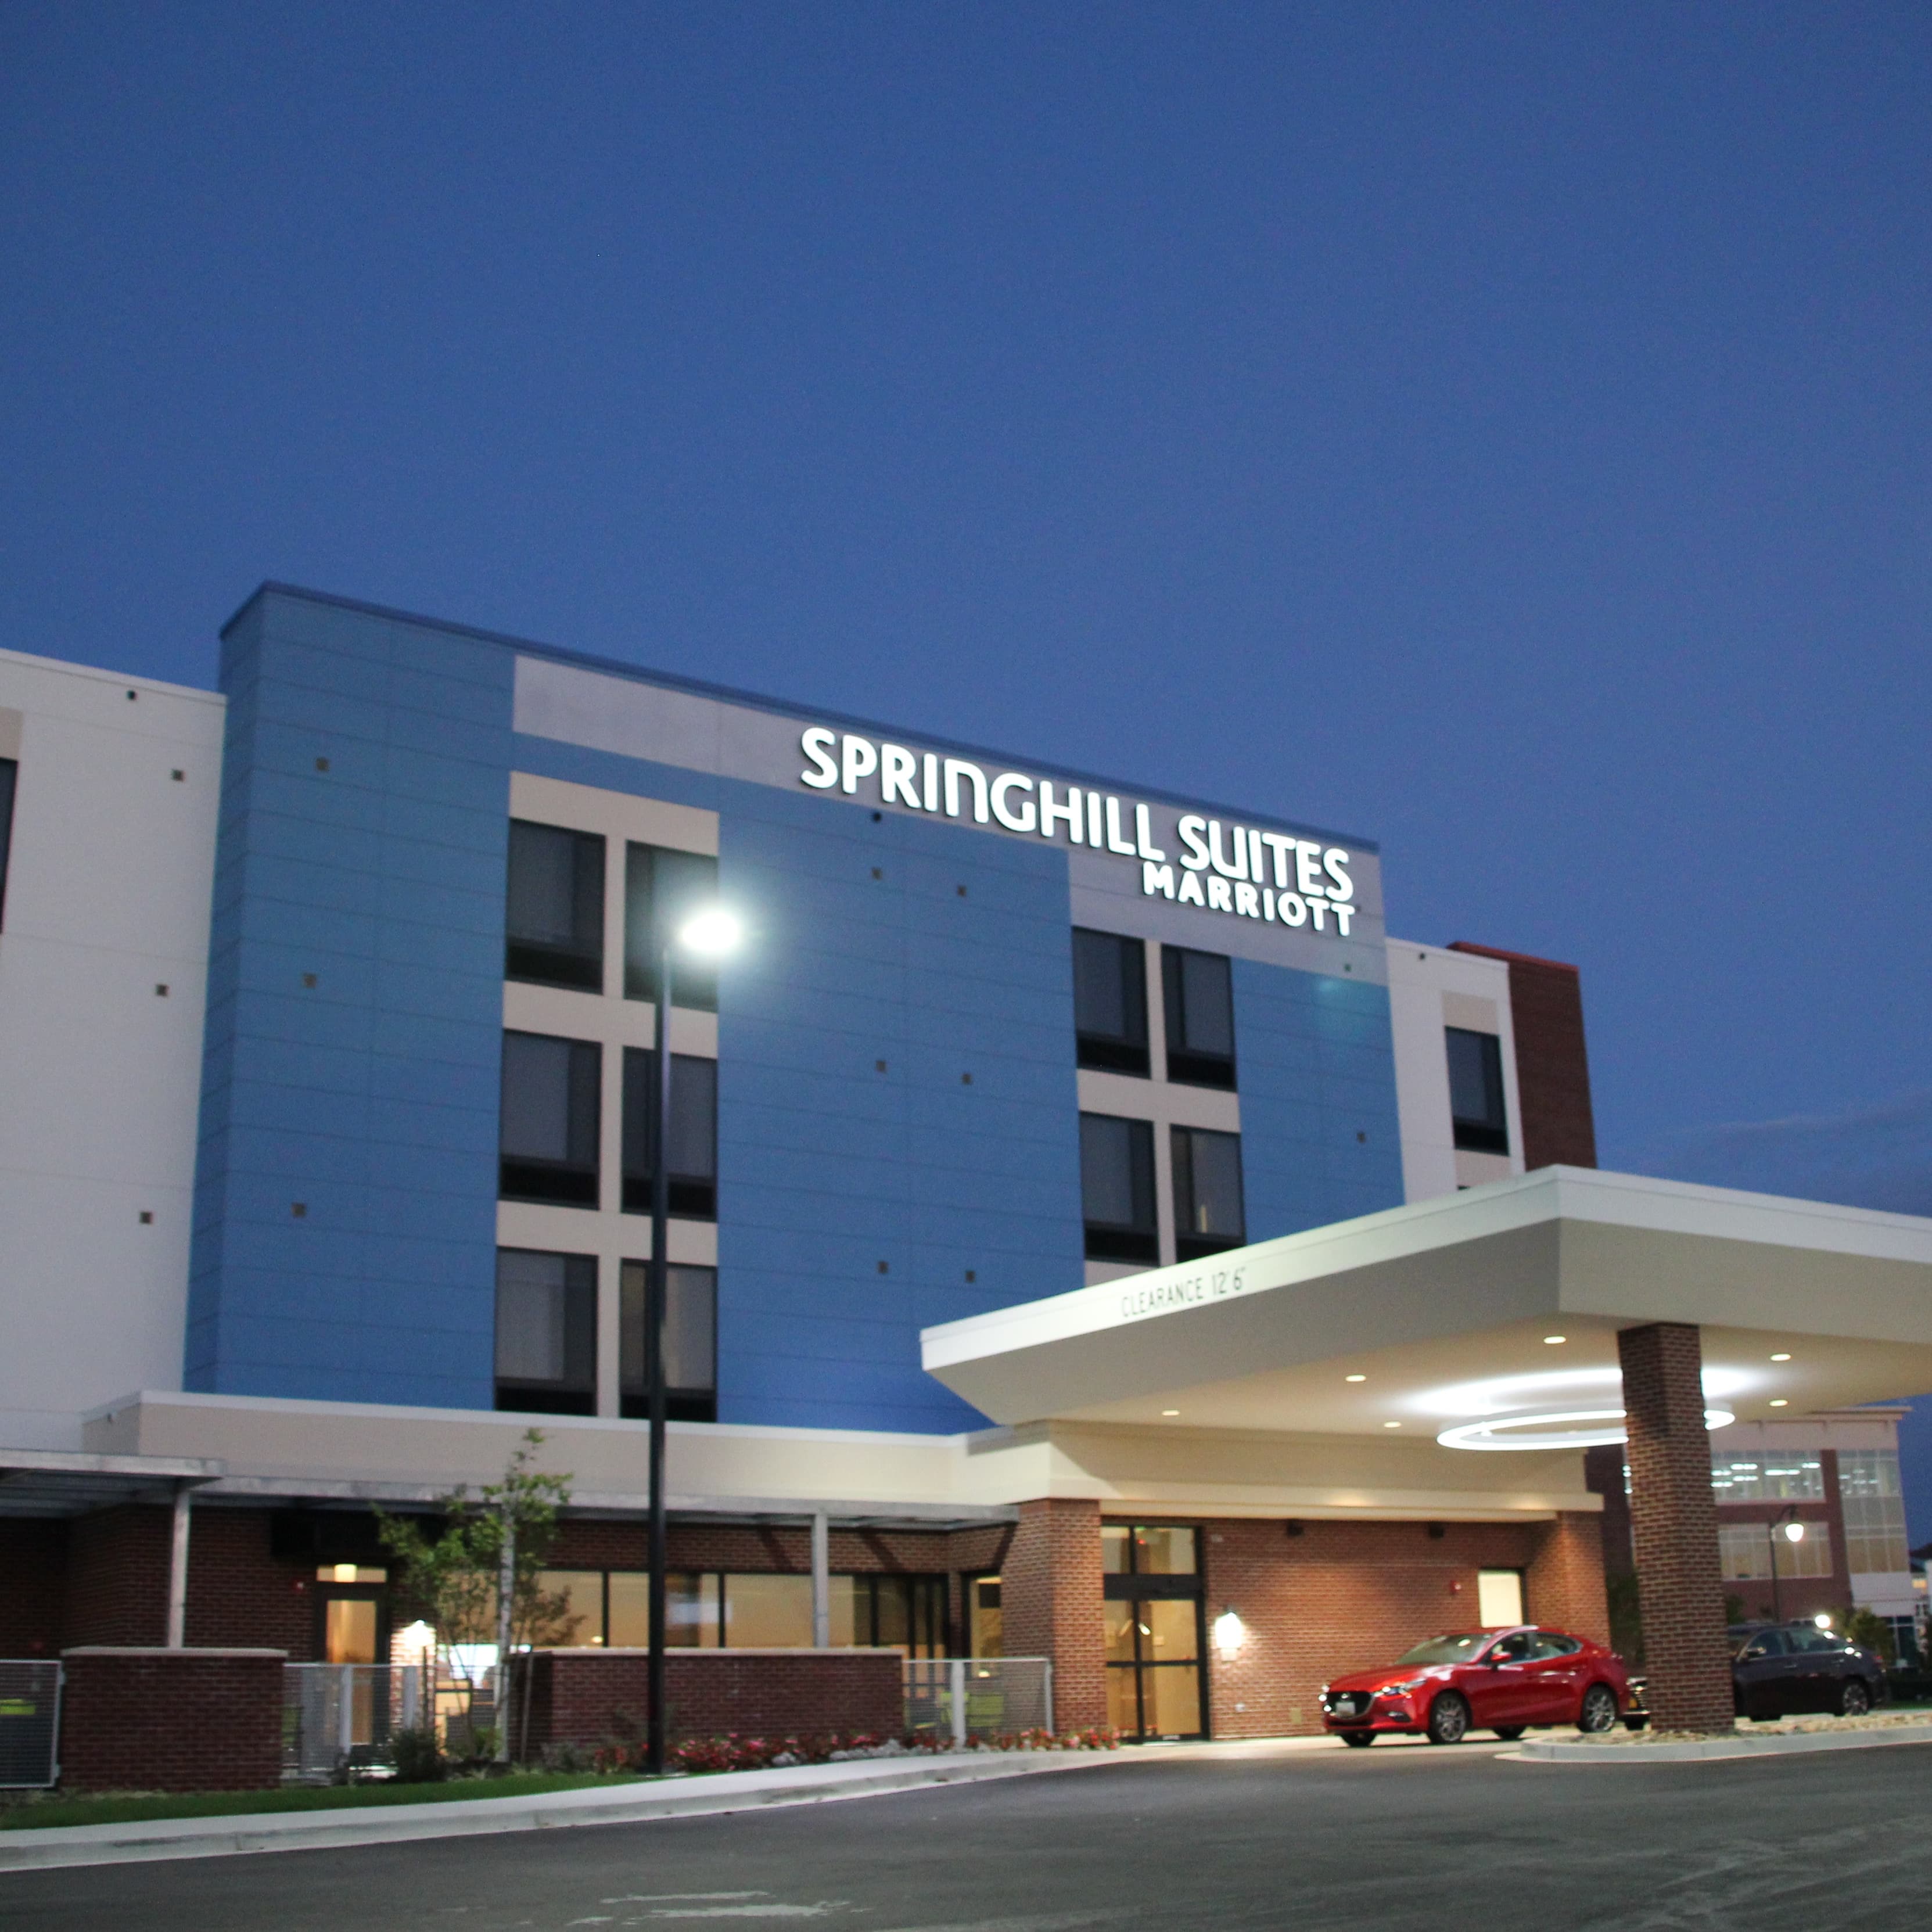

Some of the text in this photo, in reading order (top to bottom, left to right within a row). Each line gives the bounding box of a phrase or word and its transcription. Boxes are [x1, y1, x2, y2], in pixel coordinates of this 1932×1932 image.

[800, 727, 1354, 902] SPRINGHILL SUITES
[1143, 860, 1356, 936] MARRIOTT
[1122, 1277, 1204, 1317] CLEARANCE
